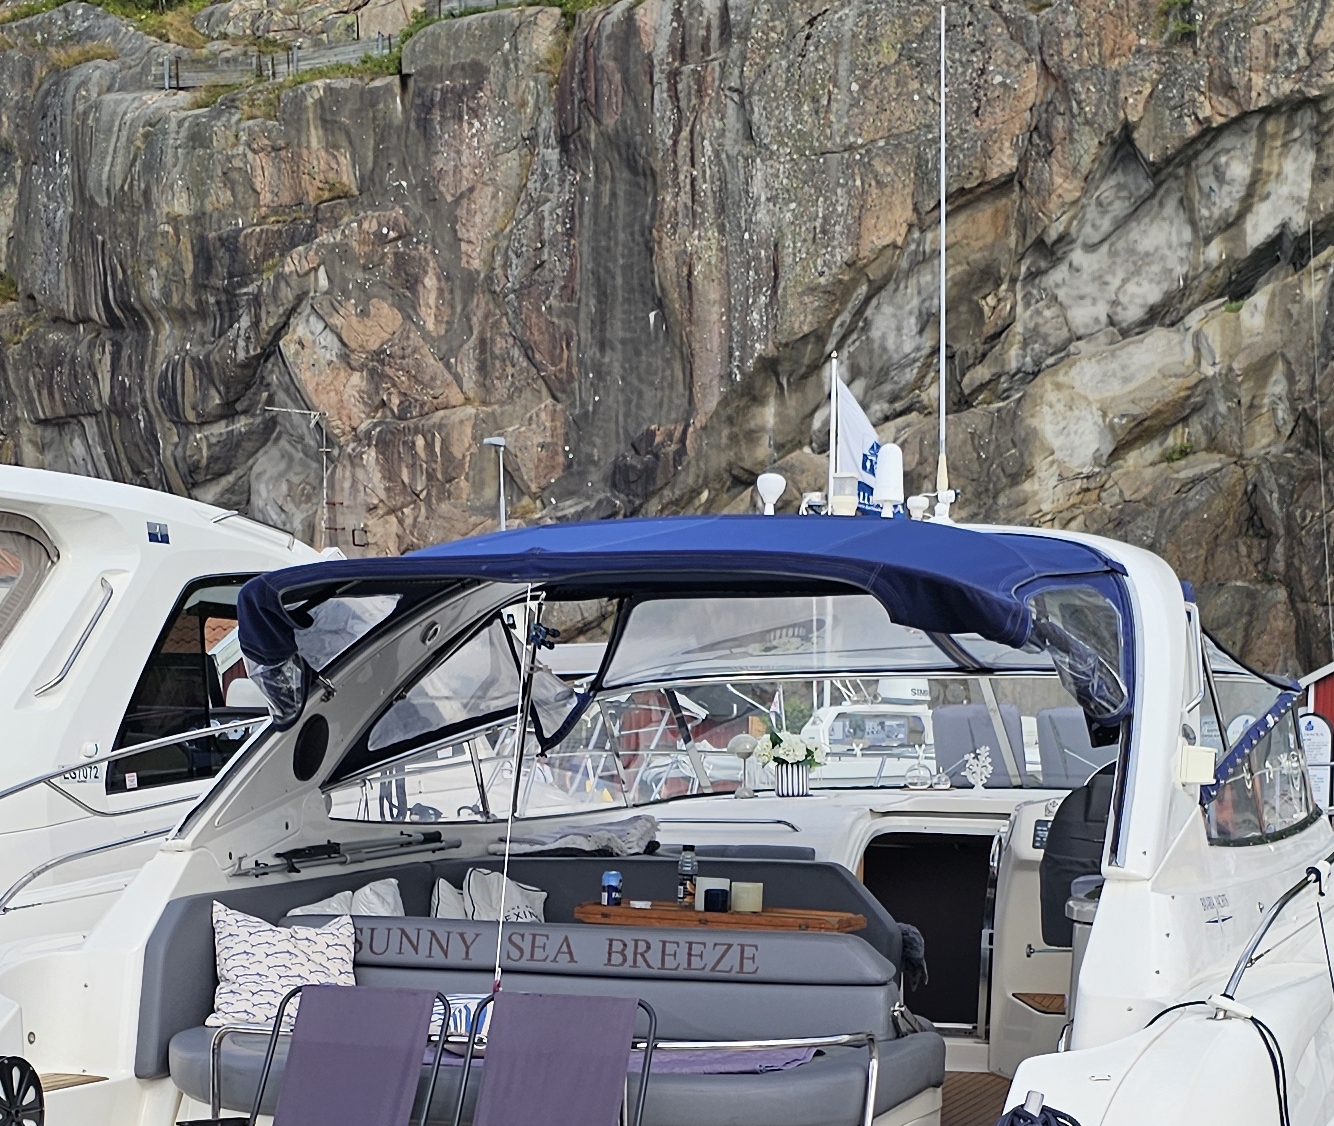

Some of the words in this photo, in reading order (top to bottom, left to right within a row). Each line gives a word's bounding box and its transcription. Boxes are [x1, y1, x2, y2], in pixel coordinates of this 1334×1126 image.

[354, 926, 483, 961] SUNNY
[505, 931, 578, 965] SEA
[604, 938, 760, 975] BREEZE
